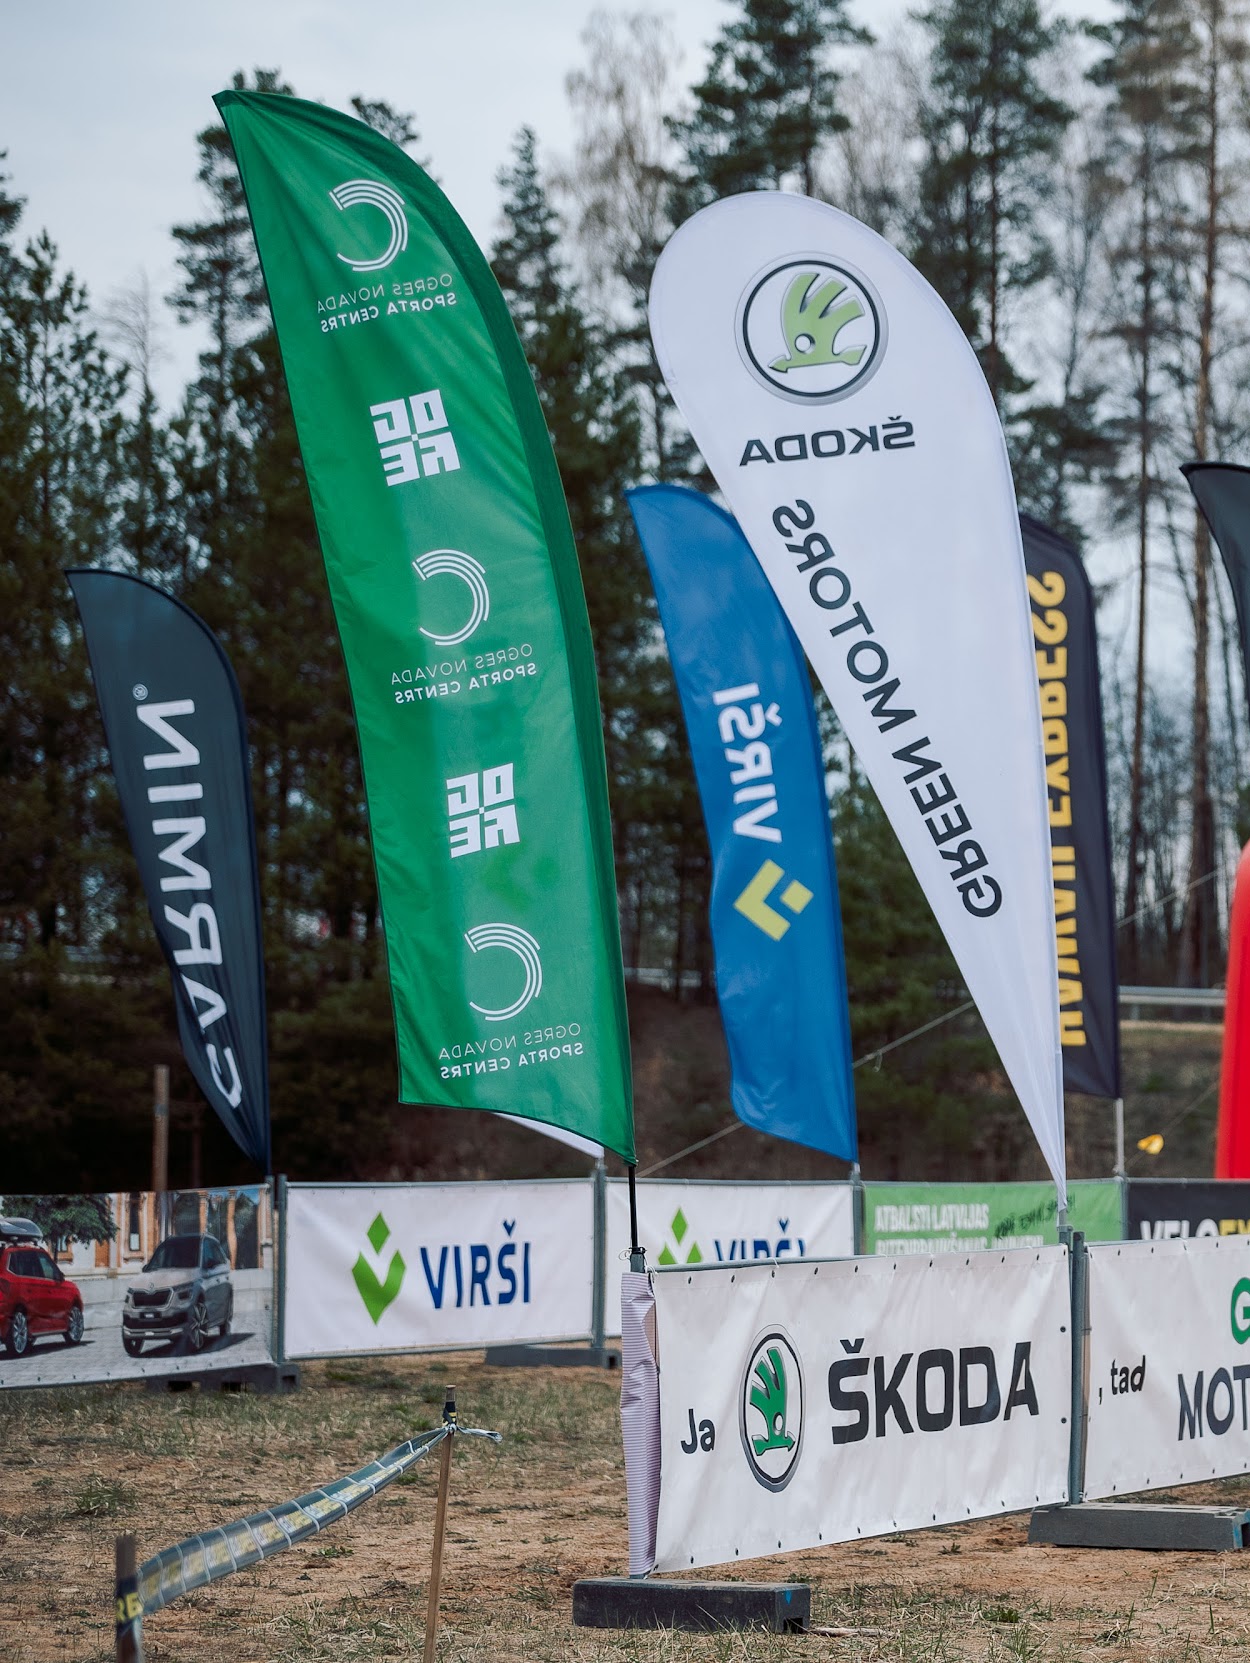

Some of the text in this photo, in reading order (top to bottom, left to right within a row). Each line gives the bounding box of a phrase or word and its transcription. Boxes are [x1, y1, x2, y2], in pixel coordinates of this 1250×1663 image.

[419, 1219, 532, 1310] VIRŠI
[680, 1337, 1040, 1455] Ja ŠKODA
[1110, 1355, 1146, 1396] tad
